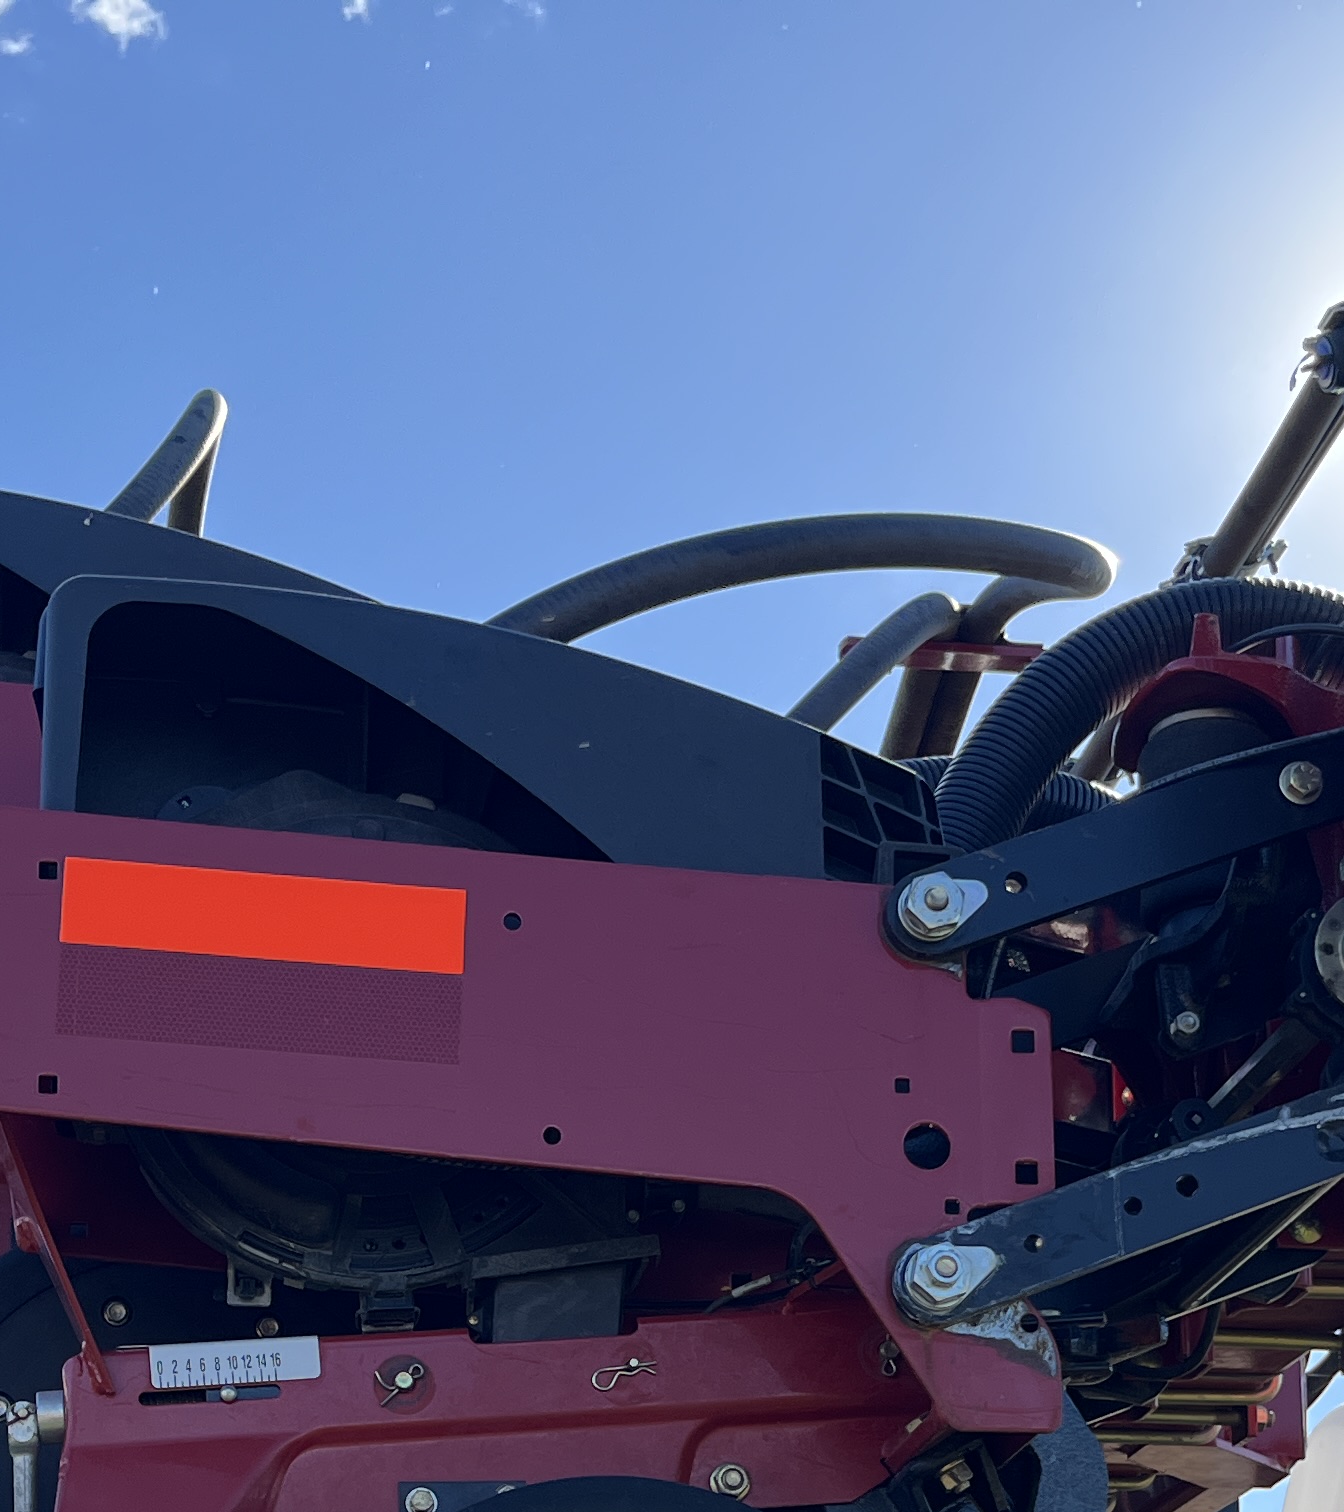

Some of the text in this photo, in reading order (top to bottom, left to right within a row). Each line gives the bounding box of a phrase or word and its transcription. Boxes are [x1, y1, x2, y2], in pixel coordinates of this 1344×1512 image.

[157, 1352, 281, 1375] 0 2 4 6 8 10 12 14 16
